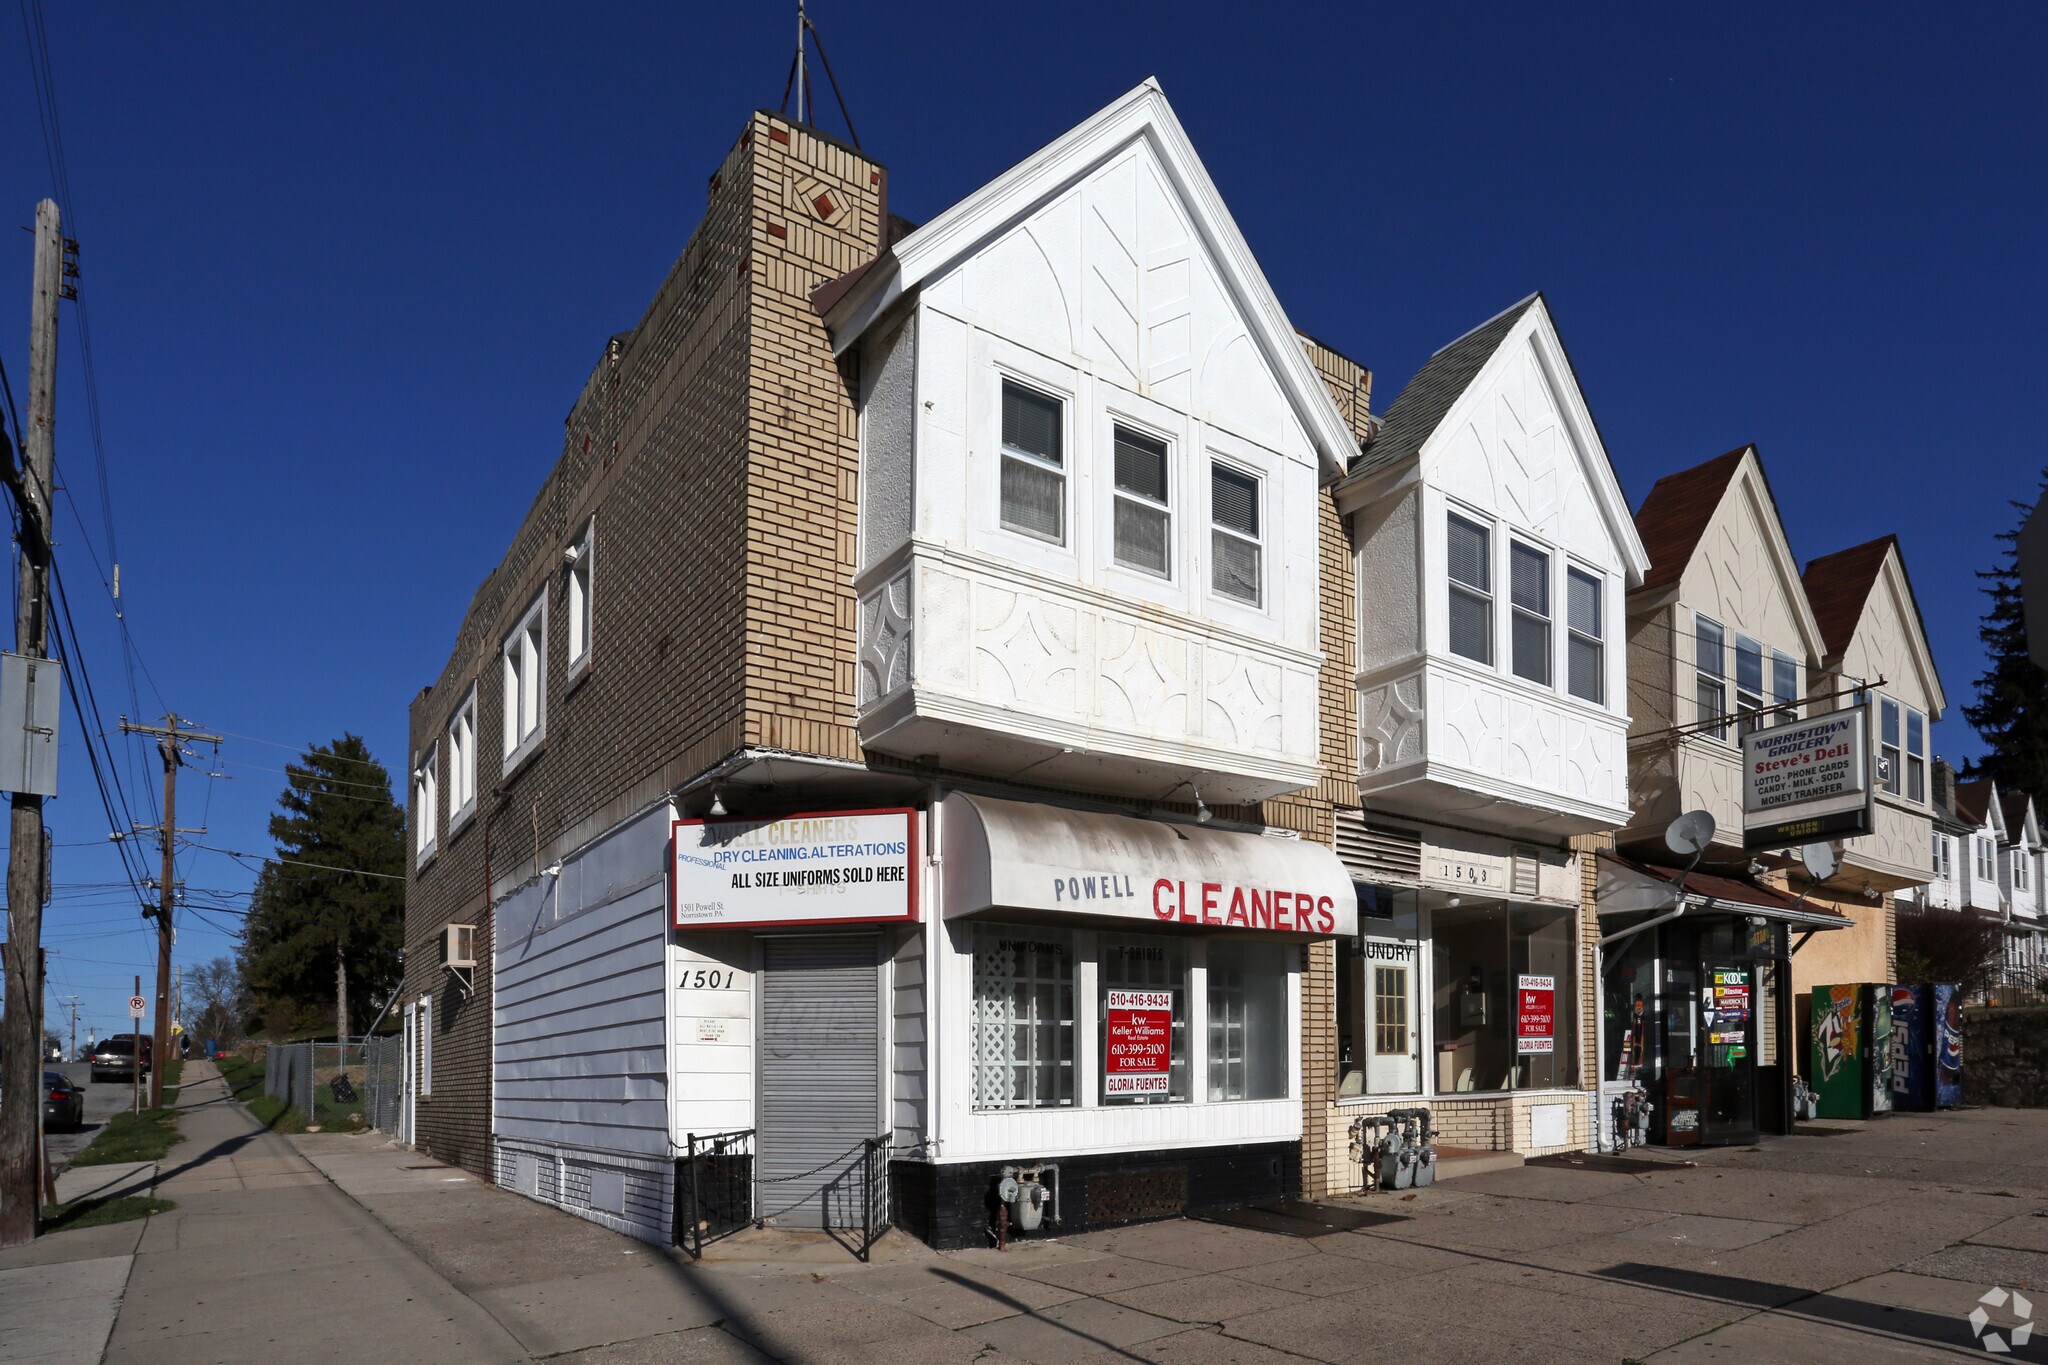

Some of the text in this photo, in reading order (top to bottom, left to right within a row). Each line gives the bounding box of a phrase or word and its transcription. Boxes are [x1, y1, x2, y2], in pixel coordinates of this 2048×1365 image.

[1754, 720, 1849, 750] NORRISTOWN
[1768, 734, 1834, 758] GROCERY
[1755, 743, 1849, 774] Steve's Deli
[1754, 774, 1781, 787] LOTTO
[1787, 767, 1817, 780] PHONE
[1819, 760, 1849, 773] CARDS
[1758, 783, 1786, 795] CANDY
[1793, 779, 1814, 789] MILK
[1821, 771, 1845, 783] SODA
[1761, 783, 1842, 806] MONEY TRANSFER
[768, 818, 858, 846] CLEANERS
[1777, 820, 1818, 832] WESTERN
[1790, 827, 1818, 836] UNION
[678, 853, 726, 870] PROFESSIONAL
[713, 850, 740, 863] DRY
[731, 866, 905, 888] ALL SIZE UNIFORMS SOLD HERE
[680, 903, 695, 912] 1501
[695, 902, 716, 912] Powell
[1054, 875, 1335, 933] POWELL CLEANERS
[998, 940, 1063, 955] UNIFORMS
[1119, 946, 1164, 960] T-SHIRTS
[679, 970, 734, 988] 1501
[1723, 972, 1744, 984] KOOL
[1525, 992, 1537, 1004] kw
[1131, 1013, 1147, 1026] kw
[1112, 1026, 1165, 1035] Keller Williams
[1111, 1043, 1165, 1055] 610-399-5100
[1519, 1041, 1552, 1050] GLORIA FUENTES
[1120, 1057, 1156, 1067] FOR SALE
[1893, 1021, 1910, 1094] PEPSI
[1109, 1077, 1167, 1091] GLORIA FUENTES
